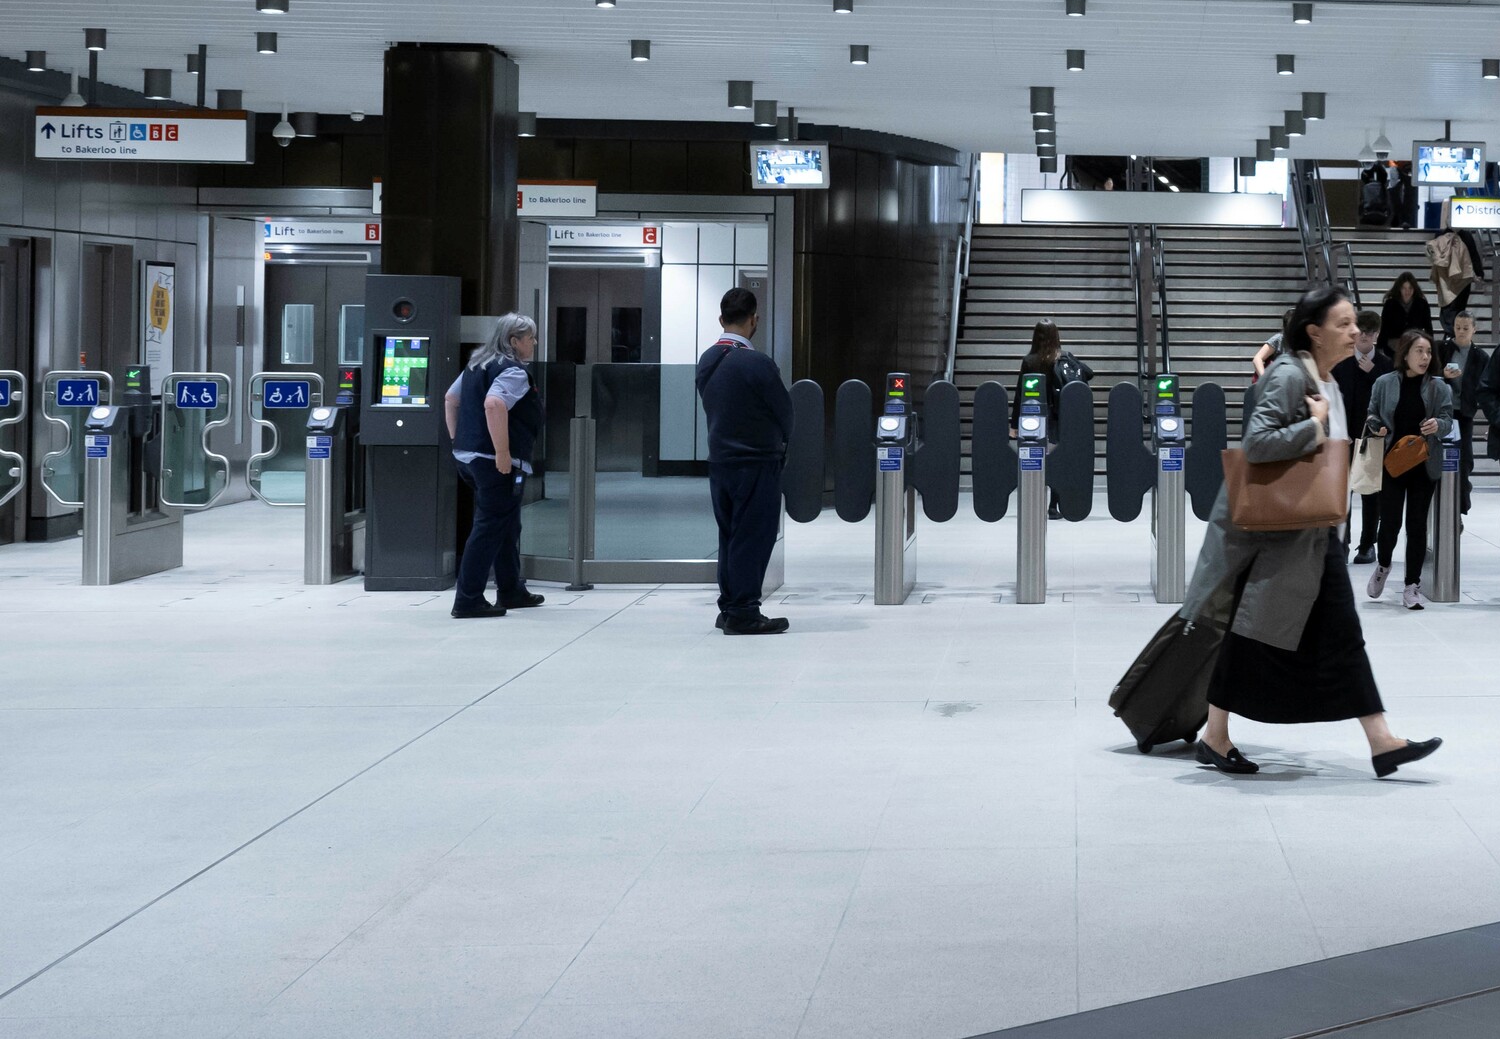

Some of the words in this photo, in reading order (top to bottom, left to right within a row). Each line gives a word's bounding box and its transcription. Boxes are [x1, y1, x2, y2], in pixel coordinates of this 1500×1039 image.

[61, 123, 103, 139] Lifts
[152, 131, 159, 139] B
[168, 131, 176, 139] C
[75, 145, 117, 154] Bakerloo
[119, 146, 137, 155] line
[540, 196, 571, 204] Bakerloo
[573, 196, 586, 204] line
[274, 226, 295, 236] Lift
[369, 229, 376, 239] B
[554, 230, 574, 239] Lift
[645, 233, 654, 242] C
